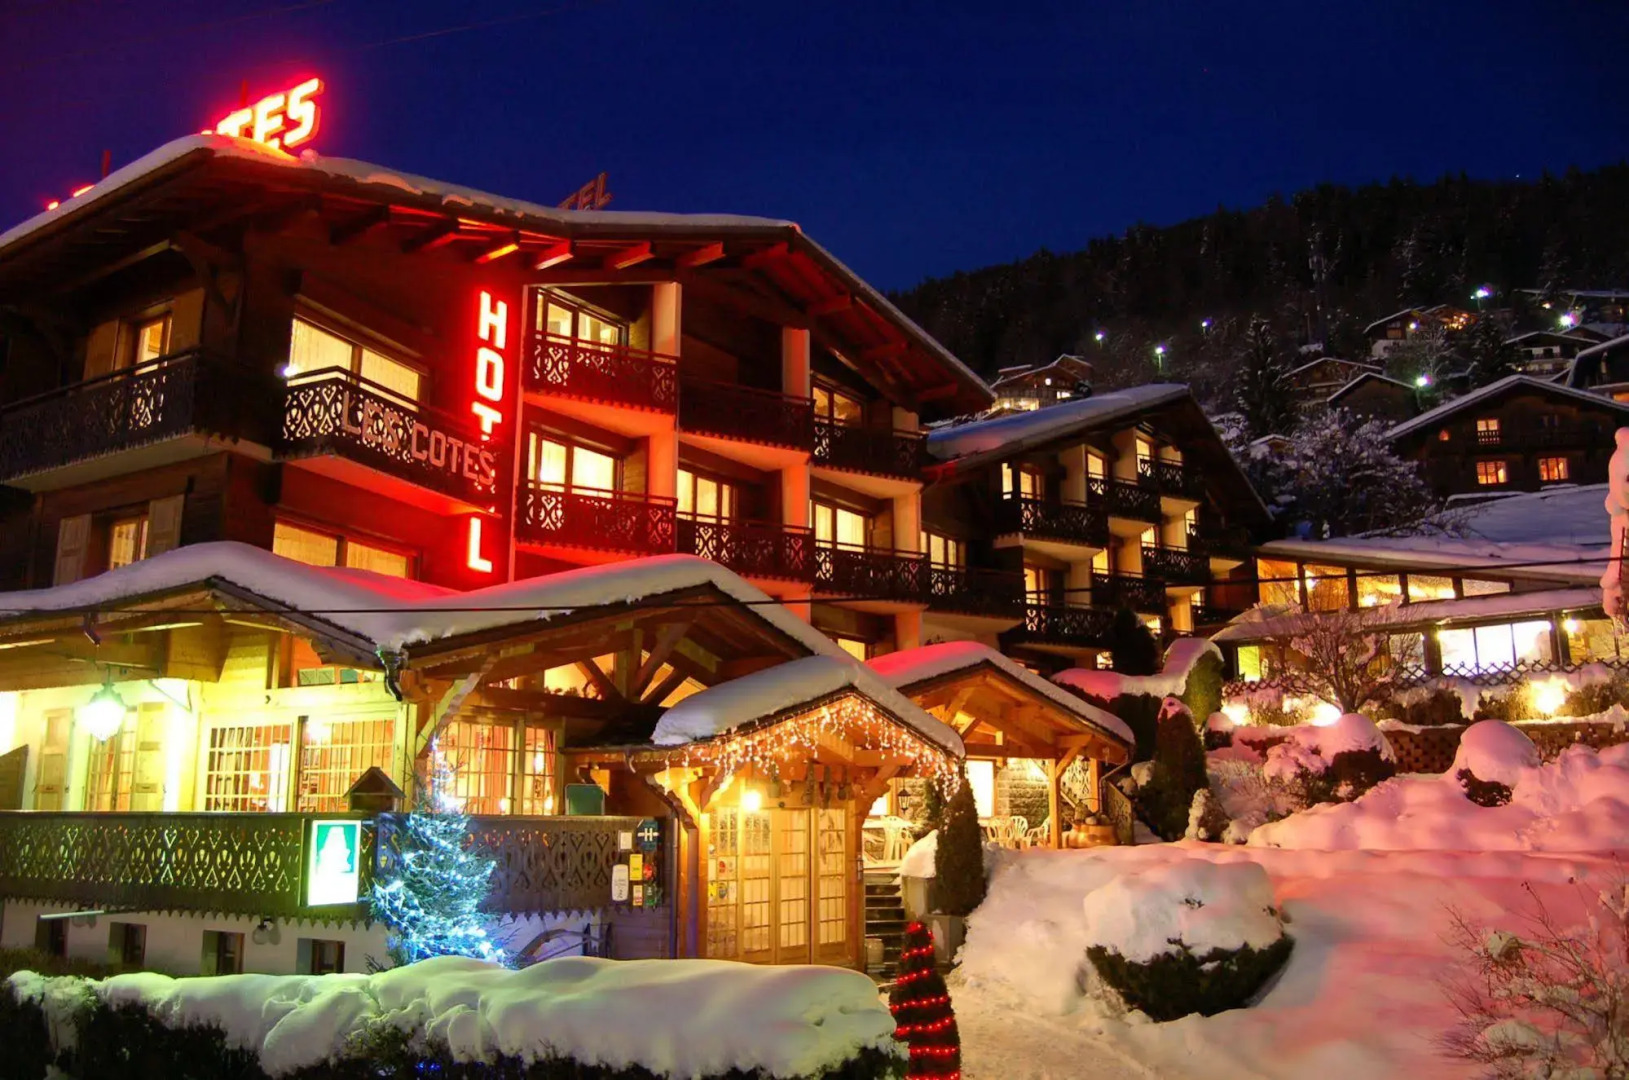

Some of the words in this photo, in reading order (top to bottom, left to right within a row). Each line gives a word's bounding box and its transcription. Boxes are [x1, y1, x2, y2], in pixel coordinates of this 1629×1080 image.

[201, 78, 324, 149] TES
[341, 390, 399, 449] LES
[411, 421, 494, 485] COTES
[467, 290, 507, 573] HOTL
